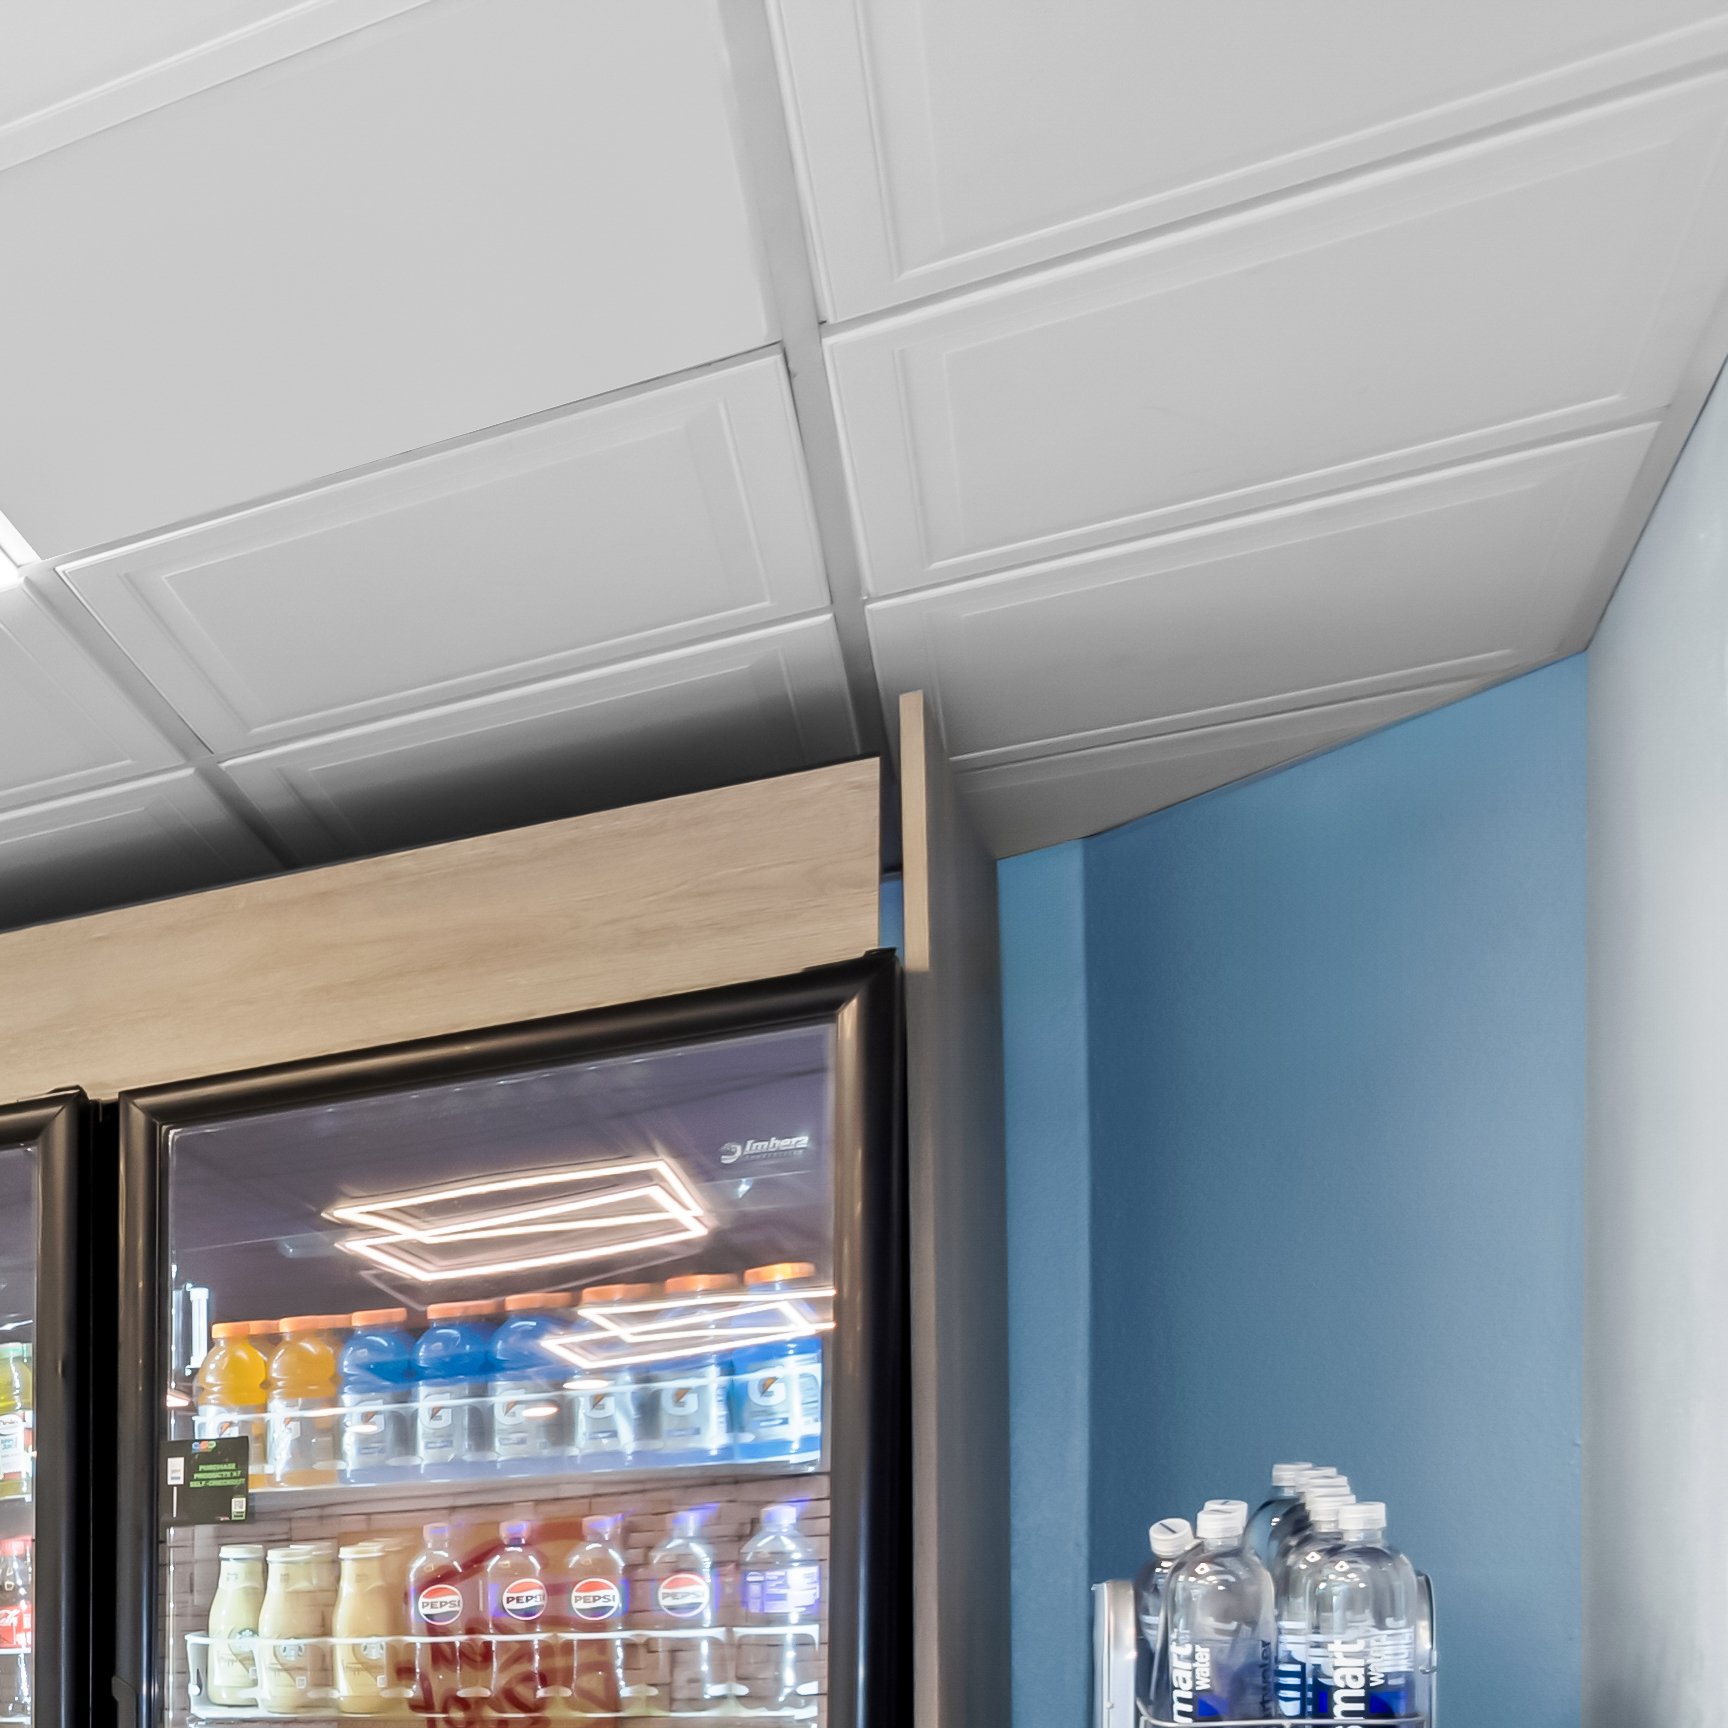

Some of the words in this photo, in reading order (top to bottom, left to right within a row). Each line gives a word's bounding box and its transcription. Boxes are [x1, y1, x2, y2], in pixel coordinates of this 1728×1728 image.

[421, 1599, 461, 1610] PEPSI
[573, 1593, 616, 1605] PEPSI
[1193, 1644, 1211, 1691] water
